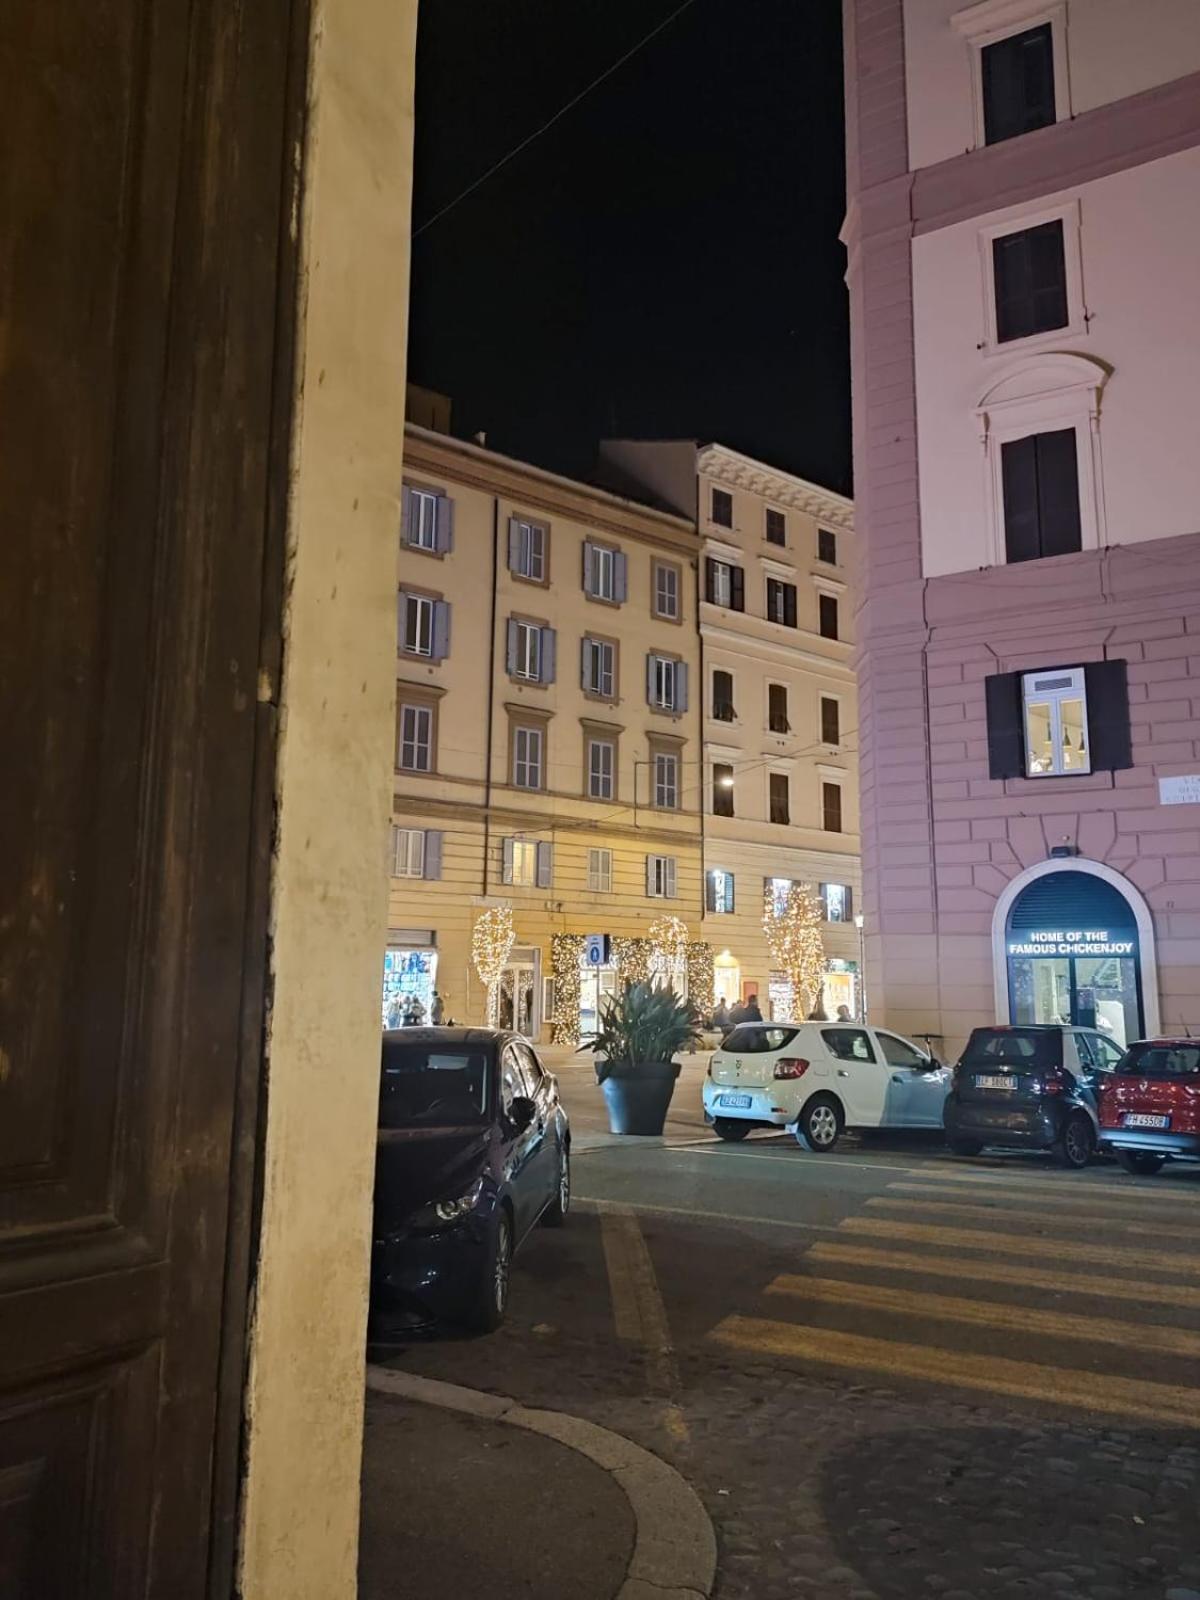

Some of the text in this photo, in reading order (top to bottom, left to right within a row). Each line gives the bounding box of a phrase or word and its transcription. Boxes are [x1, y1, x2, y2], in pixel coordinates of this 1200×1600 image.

[1031, 931, 1108, 942] HOME OF THE
[1009, 942, 1134, 954] FAMOUS CHICKENJOY
